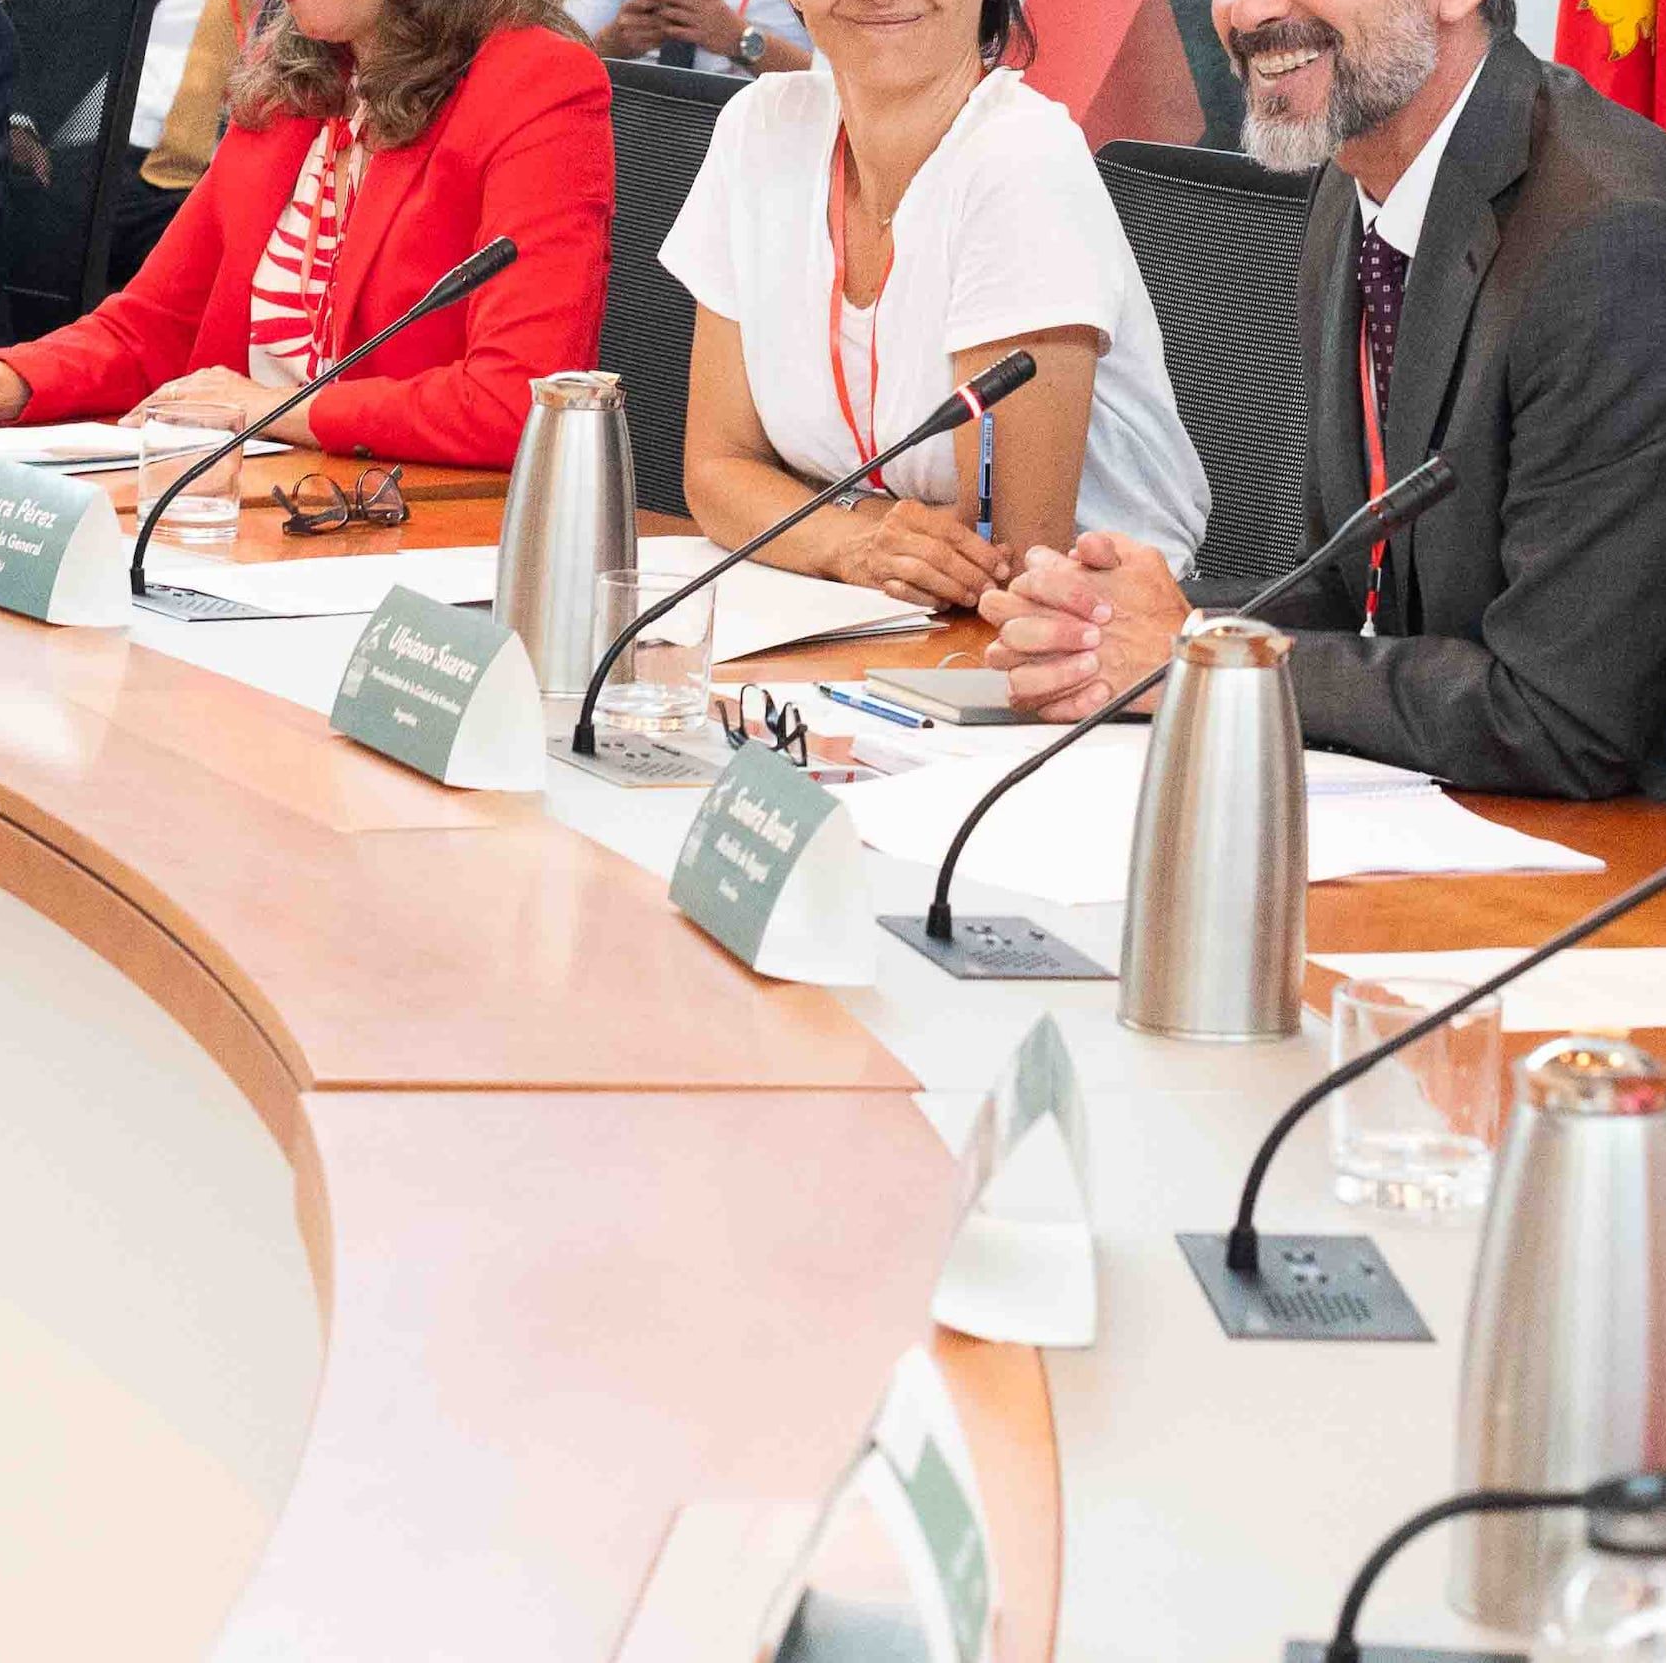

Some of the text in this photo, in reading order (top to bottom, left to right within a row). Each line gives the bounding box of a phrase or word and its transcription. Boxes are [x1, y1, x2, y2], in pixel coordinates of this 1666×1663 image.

[15, 498, 59, 530] Pérez
[7, 534, 44, 556] General
[388, 624, 436, 665] Ulpiano
